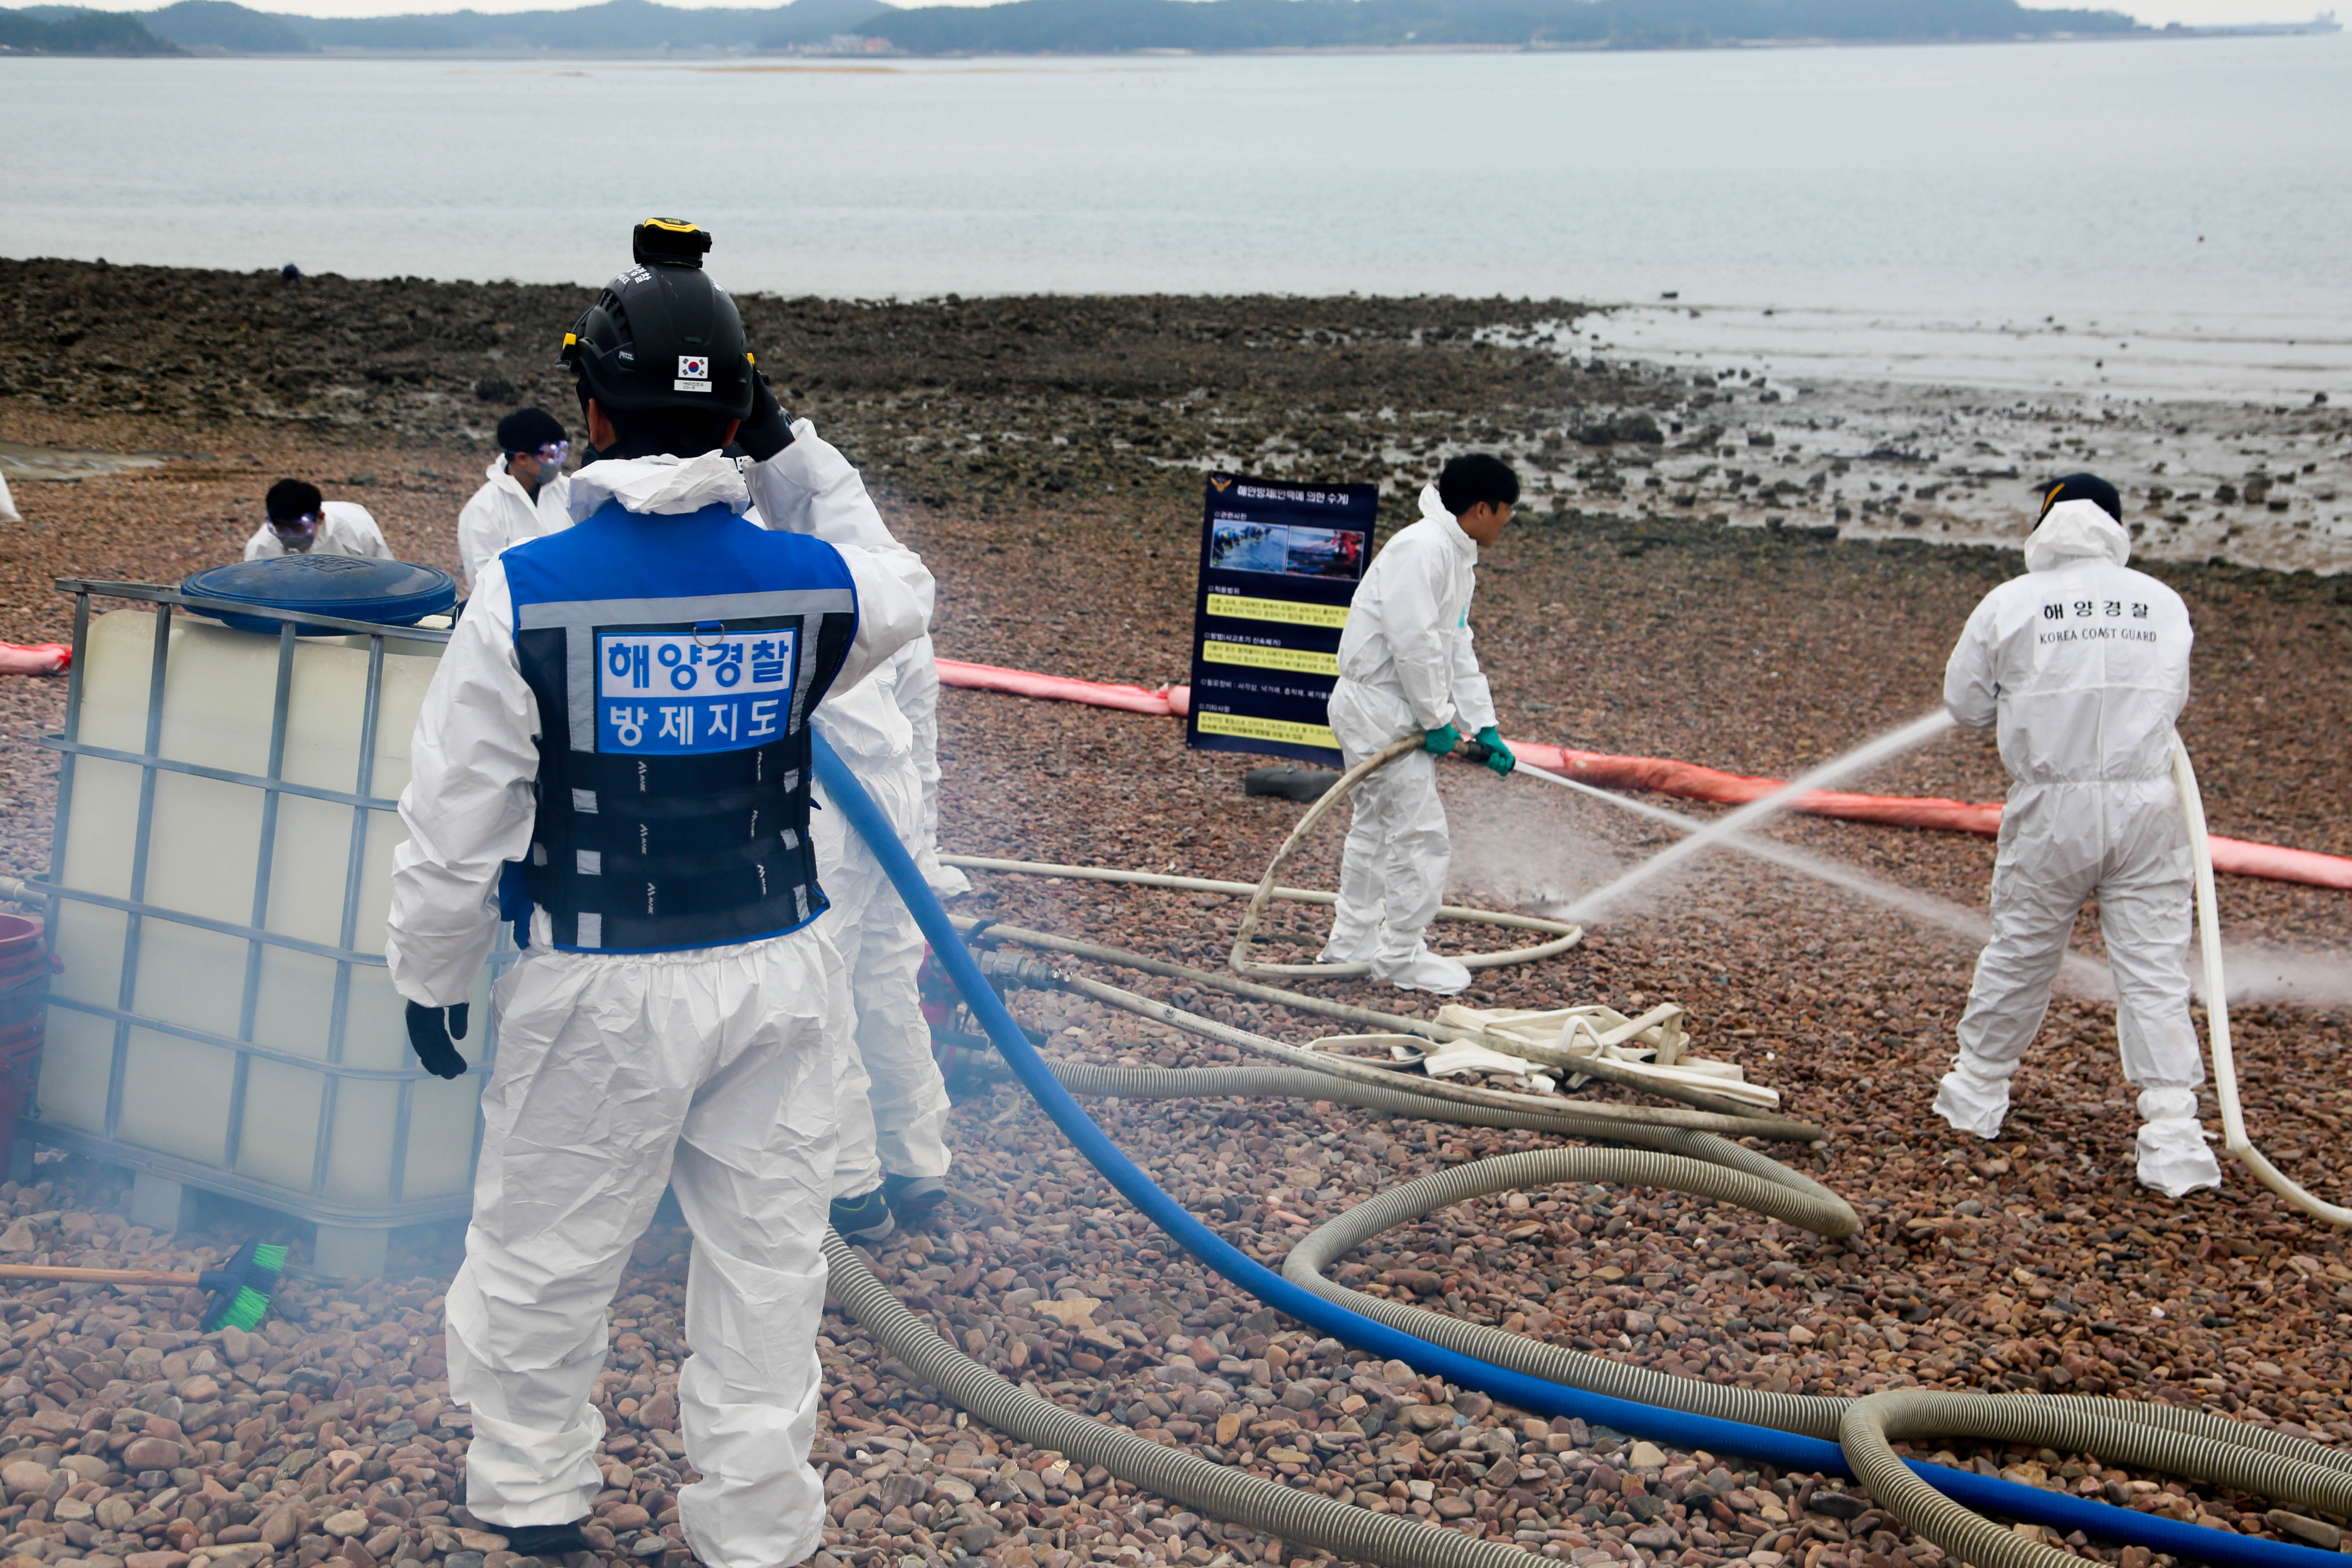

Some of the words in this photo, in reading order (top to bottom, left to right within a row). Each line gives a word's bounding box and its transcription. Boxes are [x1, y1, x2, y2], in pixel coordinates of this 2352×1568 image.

[1306, 492, 1325, 503] 의한
[2044, 600, 2148, 619] 해양경찰
[2040, 629, 2077, 645] KOREA
[2082, 627, 2117, 639] COAST
[2121, 628, 2157, 643] GUARD
[608, 639, 789, 691] 해양경찰
[610, 699, 779, 747] 방제지도
